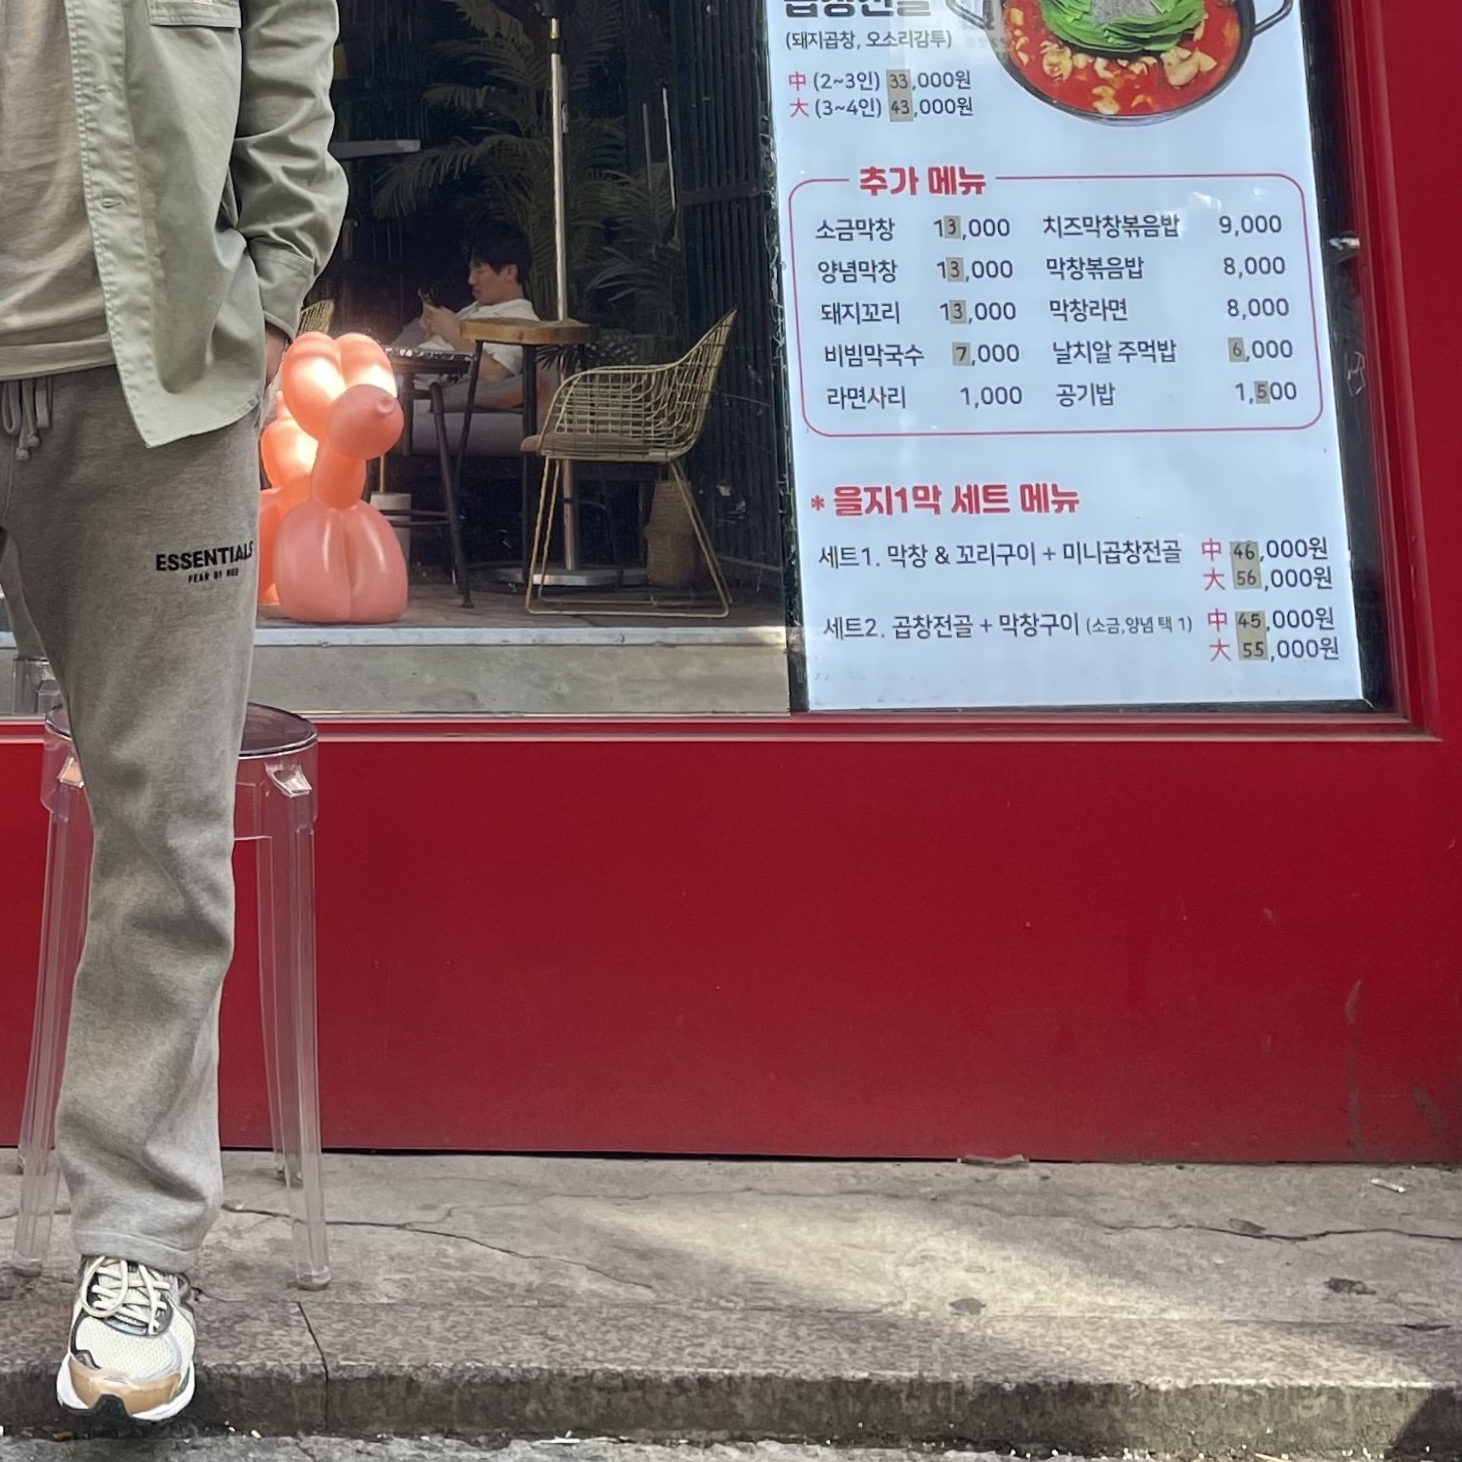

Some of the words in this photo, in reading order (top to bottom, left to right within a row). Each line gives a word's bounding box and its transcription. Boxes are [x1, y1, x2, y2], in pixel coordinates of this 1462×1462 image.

[785, 30, 861, 51] (돼지곱창,
[865, 30, 952, 49] 오소리감투)
[788, 71, 807, 92] 中
[813, 71, 880, 92] (2~3인)
[889, 69, 972, 91] 33,000원
[789, 97, 810, 118] 大
[815, 97, 882, 119] (3~4인)
[890, 96, 974, 118] 43,000원
[859, 166, 919, 196] 추가
[927, 165, 987, 196] 메뉴
[815, 217, 896, 242] 소금막창
[933, 218, 1010, 241] 13,000
[1042, 214, 1180, 239] 치즈막창볶음밥
[1219, 214, 1282, 237] 9,000
[817, 259, 899, 284] 양념막창
[936, 259, 1013, 283] 13,000
[1046, 256, 1145, 281] 막창볶음밥
[1223, 256, 1286, 279] 8,000
[821, 301, 900, 325] 돼지꼬리
[939, 300, 1016, 325] 13,000
[1049, 298, 1128, 323] 막창라면
[1227, 297, 1290, 321] 8,000
[824, 343, 925, 368] 비빔막국수
[955, 343, 1020, 367] 7,000
[1053, 340, 1112, 365] 날치알
[1117, 339, 1177, 364] 주먹밥
[1232, 338, 1293, 363] 6,000
[827, 385, 906, 410] 라면사리
[960, 386, 1023, 409] 1,000
[1055, 382, 1116, 408] 공기밥
[1235, 380, 1297, 405] 1,500
[833, 484, 943, 517] 을지1막
[951, 484, 1011, 515] 세트
[1019, 482, 1080, 514] 메뉴
[156, 541, 253, 571] ESSENTIALS
[818, 545, 880, 570] 세트1.
[887, 544, 929, 569] 막창
[934, 545, 951, 565] &
[956, 542, 1036, 567] 꼬리구이
[1042, 546, 1057, 561] +
[1062, 539, 1182, 565] 미니곱창전골
[1201, 537, 1222, 562] 中
[1233, 536, 1328, 562] 46,000원
[1202, 567, 1226, 592] 大
[1236, 565, 1333, 592] 56,000원
[823, 616, 885, 641] 세트2.
[892, 614, 974, 640] 곱창전골
[979, 618, 993, 633] +
[998, 612, 1079, 638] 막창구이
[1207, 608, 1228, 632] 中
[1237, 606, 1335, 632] 45,000원
[1209, 638, 1232, 662] 大
[1242, 636, 1340, 663] 55,000원
